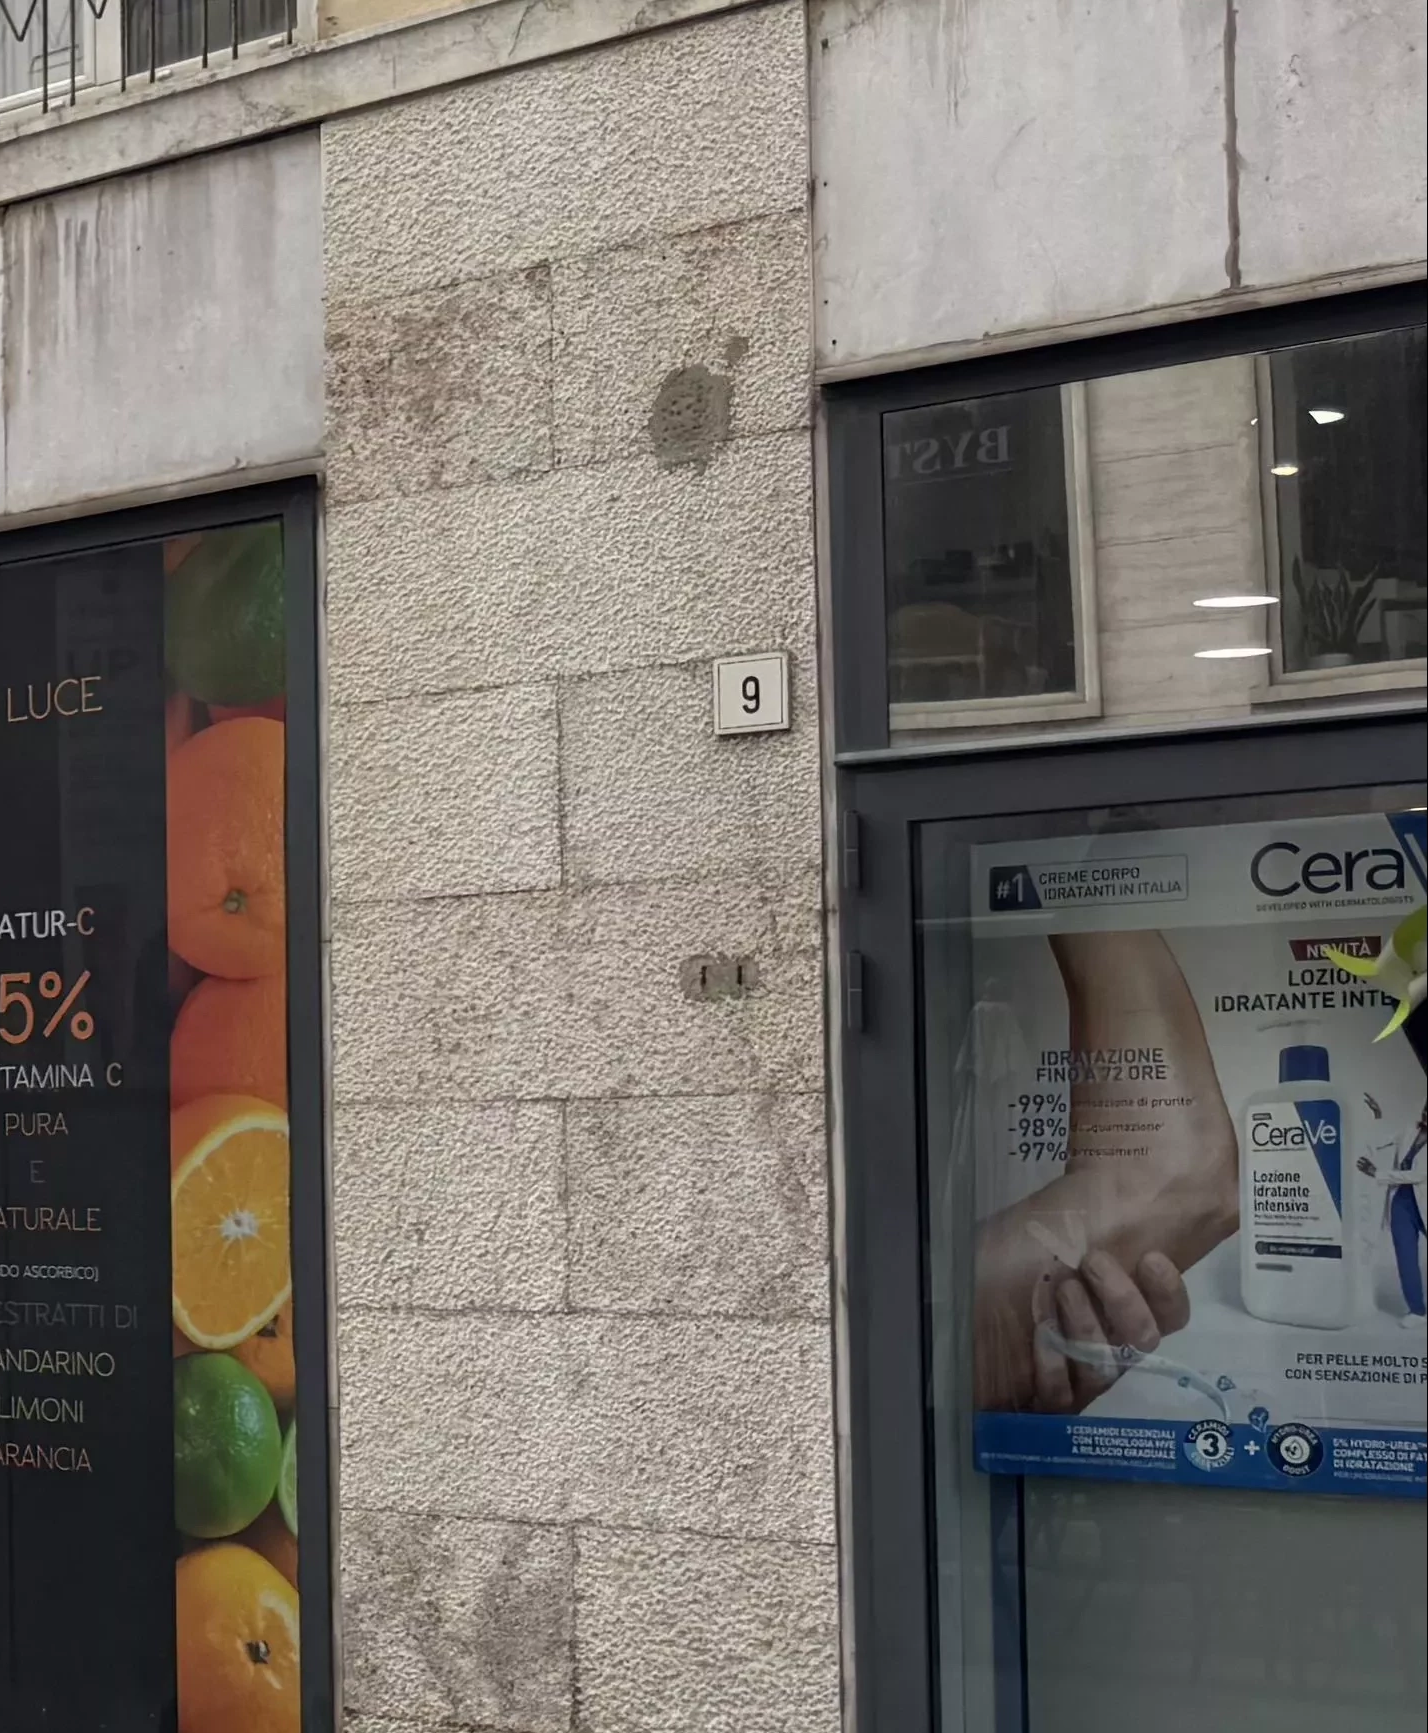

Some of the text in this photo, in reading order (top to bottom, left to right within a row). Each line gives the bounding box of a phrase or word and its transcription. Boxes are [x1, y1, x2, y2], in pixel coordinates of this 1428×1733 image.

[7, 676, 103, 722] LUCE
[742, 676, 760, 714] 9
[1038, 866, 1141, 886] CREME CORPO
[994, 873, 1025, 903] #1
[1043, 880, 1182, 900] IDRATANTI IN ITALIA
[1215, 989, 1394, 1013] IDRATANTE INTE
[1041, 1047, 1164, 1067] IDRATAZIONE
[106, 1062, 122, 1088] C
[1036, 1064, 1168, 1083] FINO A 72 ORE
[1008, 1093, 1067, 1115] -99%
[5, 1112, 69, 1136] PURA
[1008, 1118, 1067, 1138] -98%
[1252, 1119, 1337, 1147] CeraVe
[1008, 1142, 1068, 1162] -97%
[29, 1160, 47, 1184] E
[1253, 1170, 1301, 1183] Lozione
[1254, 1184, 1310, 1198] Idratante
[1254, 1199, 1309, 1213] Intensiva
[115, 1305, 138, 1329] DI
[1296, 1352, 1323, 1366] PER
[1326, 1353, 1369, 1367] PELLE
[1372, 1355, 1416, 1368] MOLTO
[1285, 1368, 1312, 1381] CON
[1315, 1369, 1400, 1384] SENSAZIONE
[1403, 1372, 1416, 1384] DI
[1201, 1432, 1219, 1458] 3
